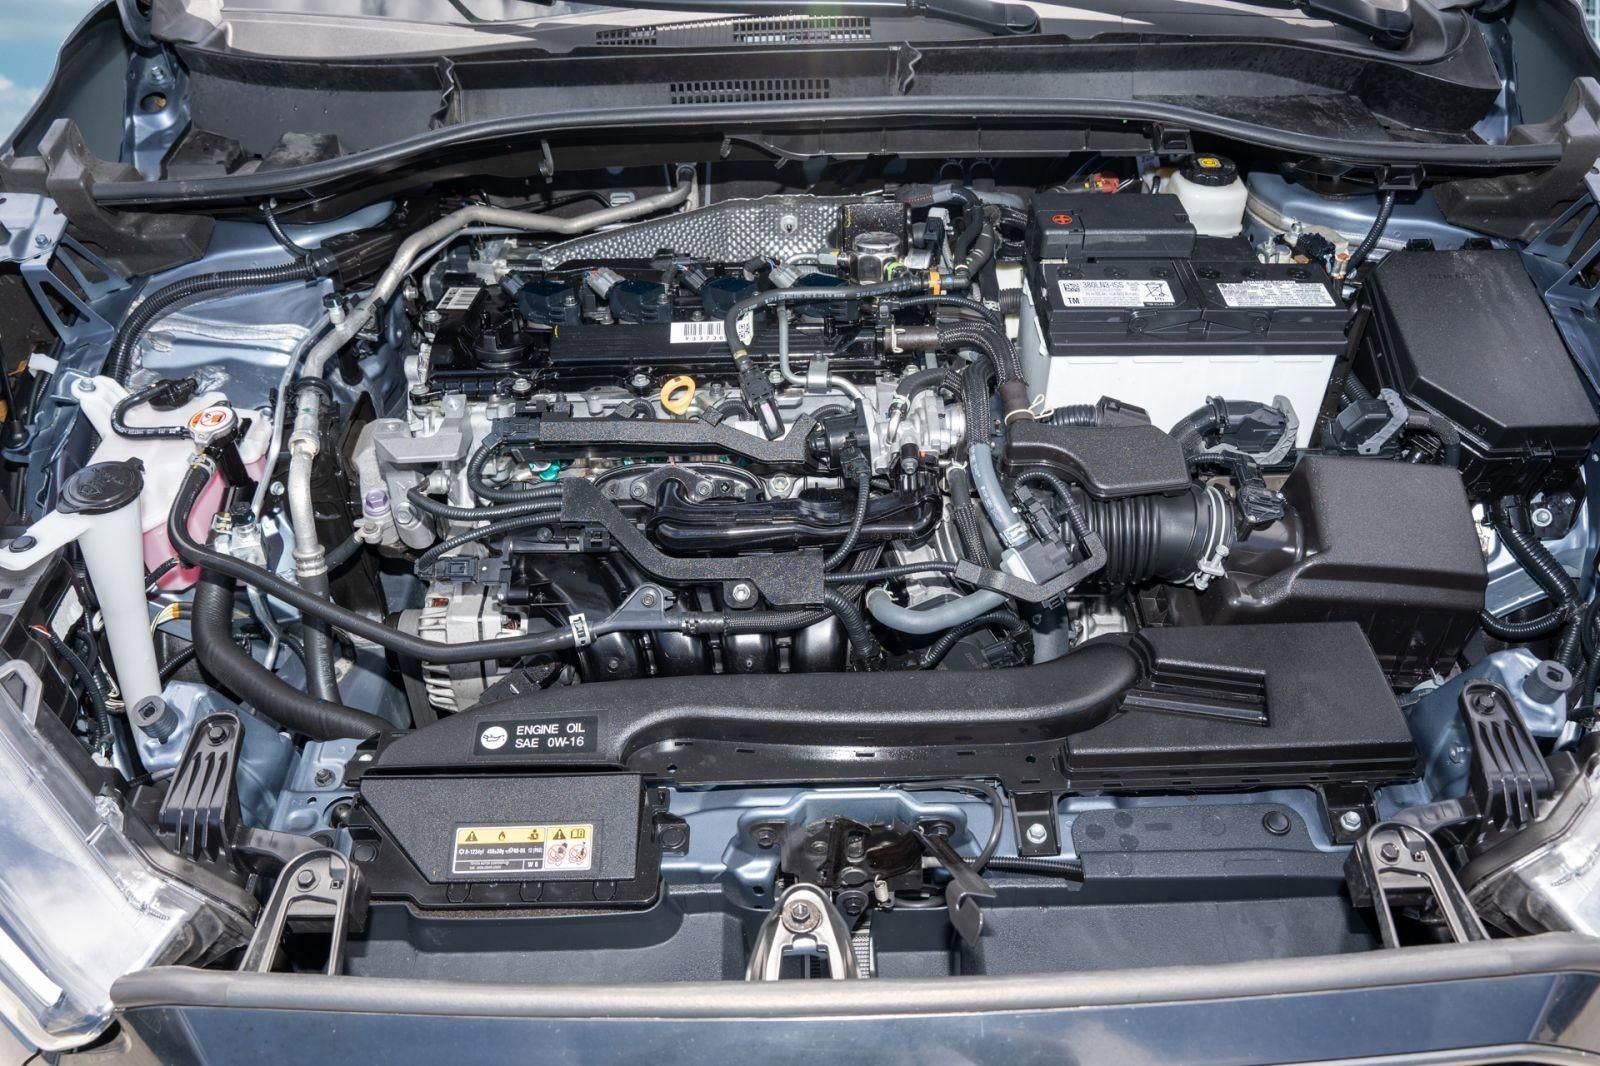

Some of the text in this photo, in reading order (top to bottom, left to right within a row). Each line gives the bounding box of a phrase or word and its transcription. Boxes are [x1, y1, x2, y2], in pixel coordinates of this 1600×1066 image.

[1067, 297, 1080, 305] TM
[516, 722, 586, 736] ENGINE OIL
[514, 736, 585, 749] SAE 0W-16
